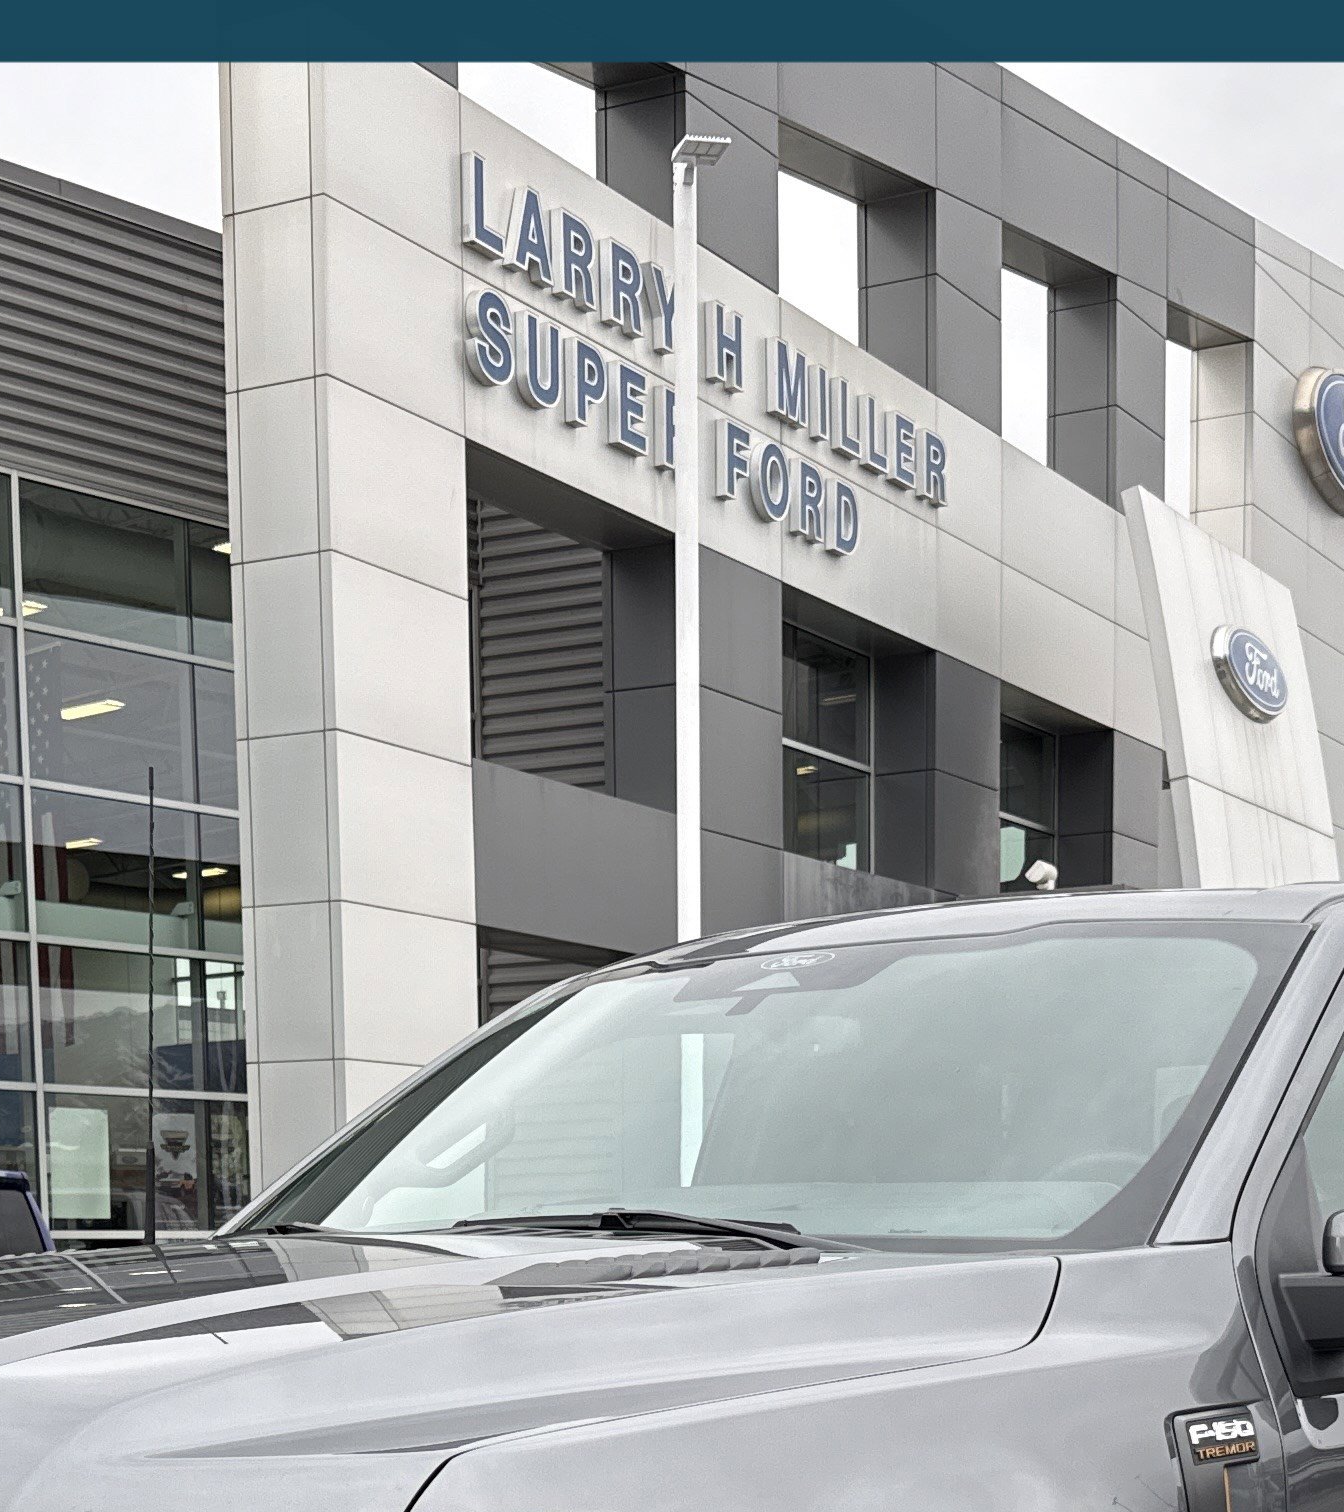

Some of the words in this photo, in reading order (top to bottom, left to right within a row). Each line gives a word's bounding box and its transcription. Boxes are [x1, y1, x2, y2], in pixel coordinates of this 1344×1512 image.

[462, 152, 675, 354] LARRY
[705, 300, 743, 393] H
[765, 336, 948, 507] MILLER
[716, 417, 860, 556] FORD
[1244, 641, 1280, 699] Ford
[1188, 1419, 1255, 1445] F-150
[1197, 1441, 1256, 1460] TREMOR
